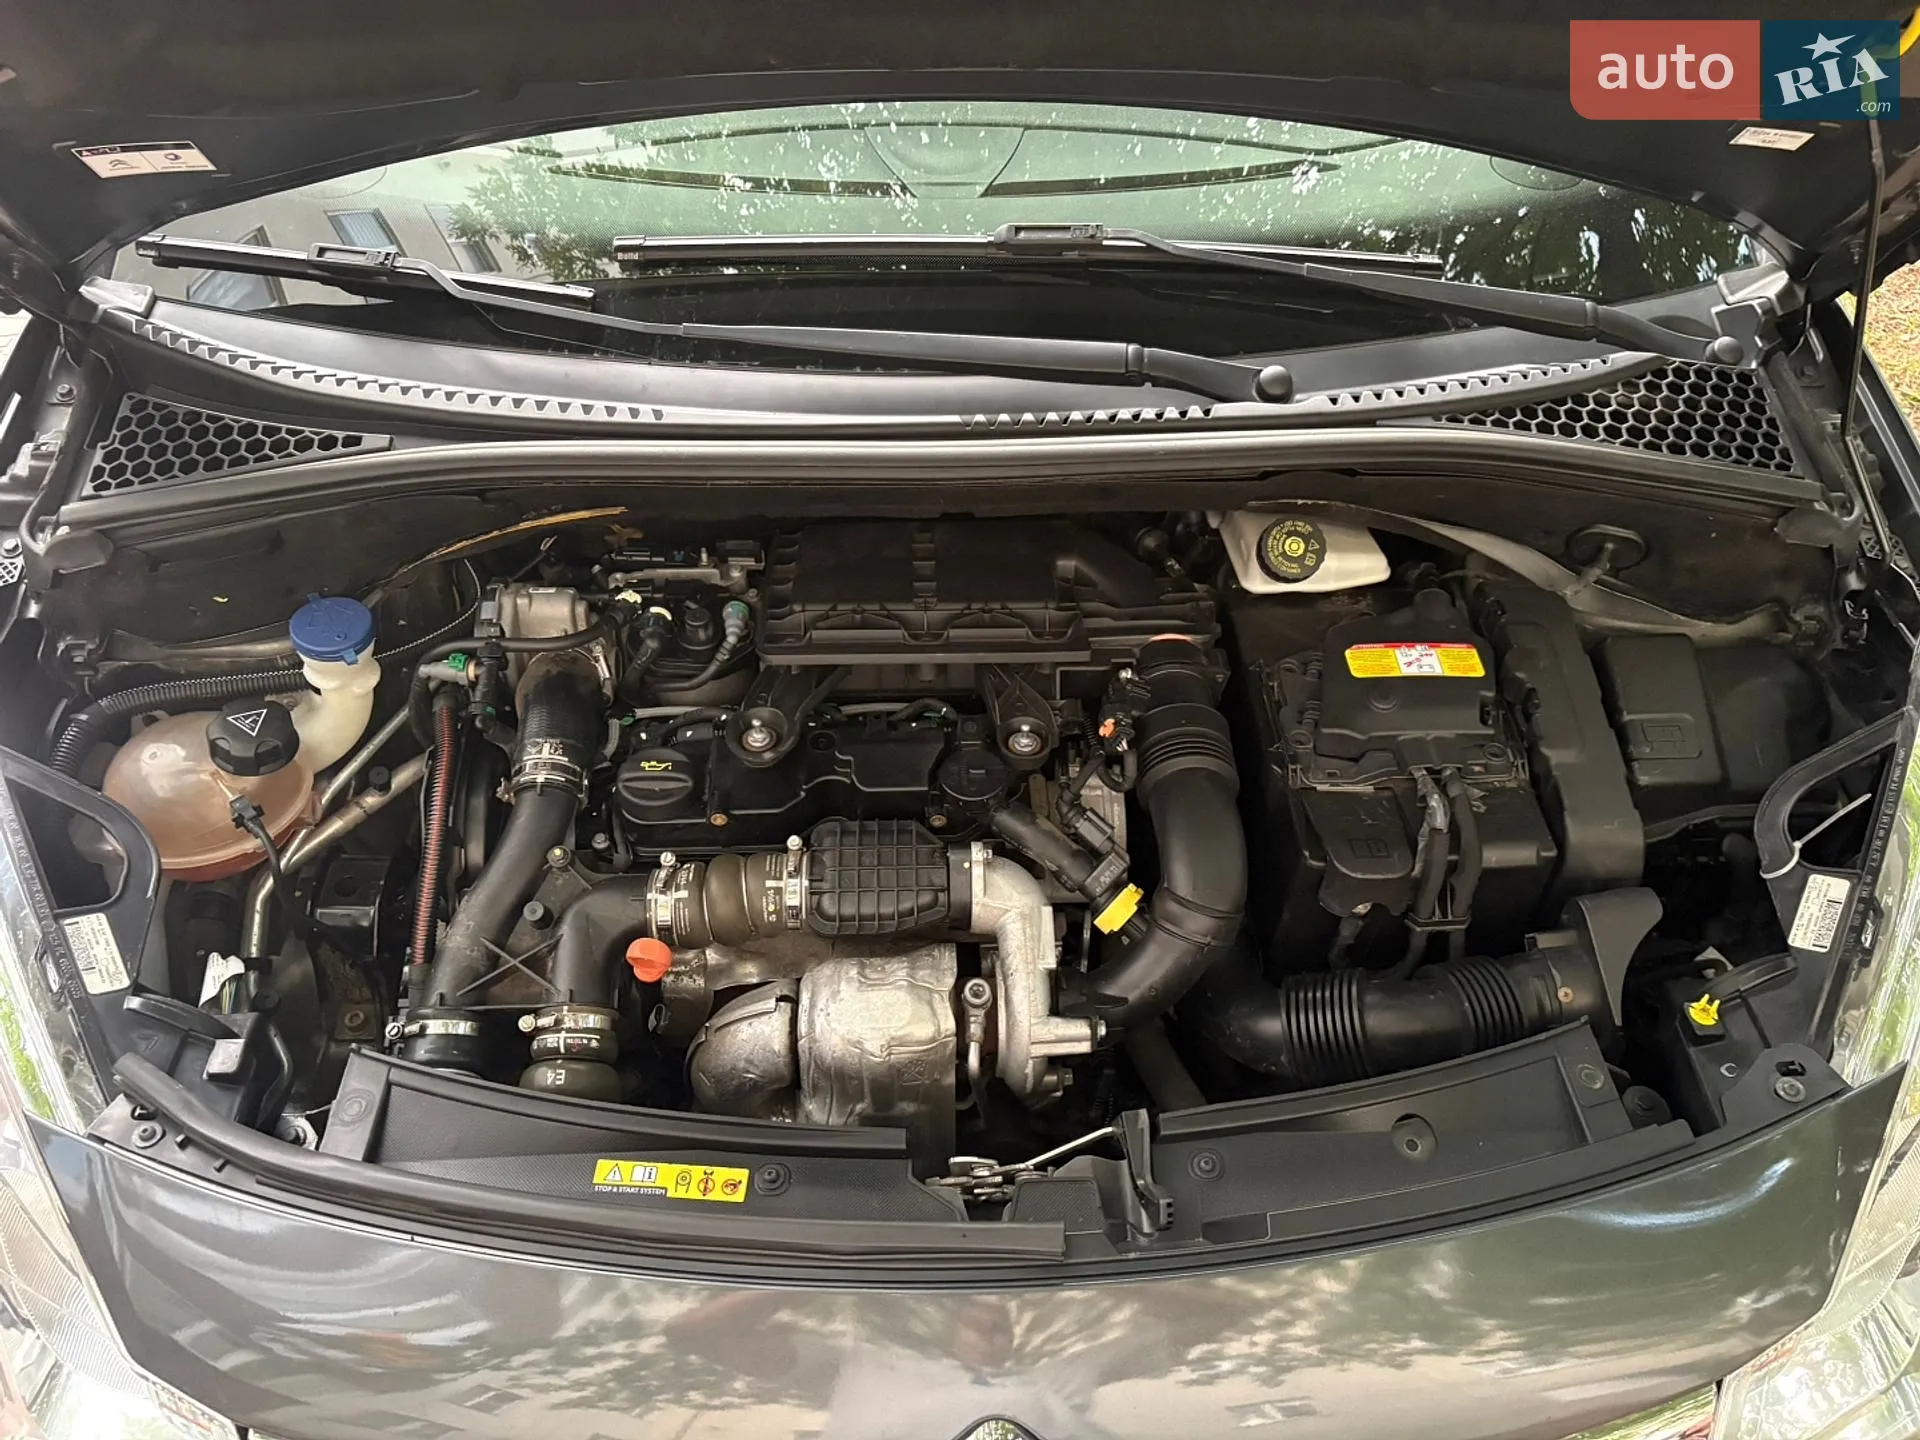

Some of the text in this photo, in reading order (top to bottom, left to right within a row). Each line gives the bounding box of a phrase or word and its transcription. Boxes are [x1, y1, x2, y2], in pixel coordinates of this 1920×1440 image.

[546, 1069, 566, 1086] E4
[594, 1185, 612, 1193] STOP
[618, 1186, 639, 1194] START
[639, 1187, 666, 1196] SYSTEM
